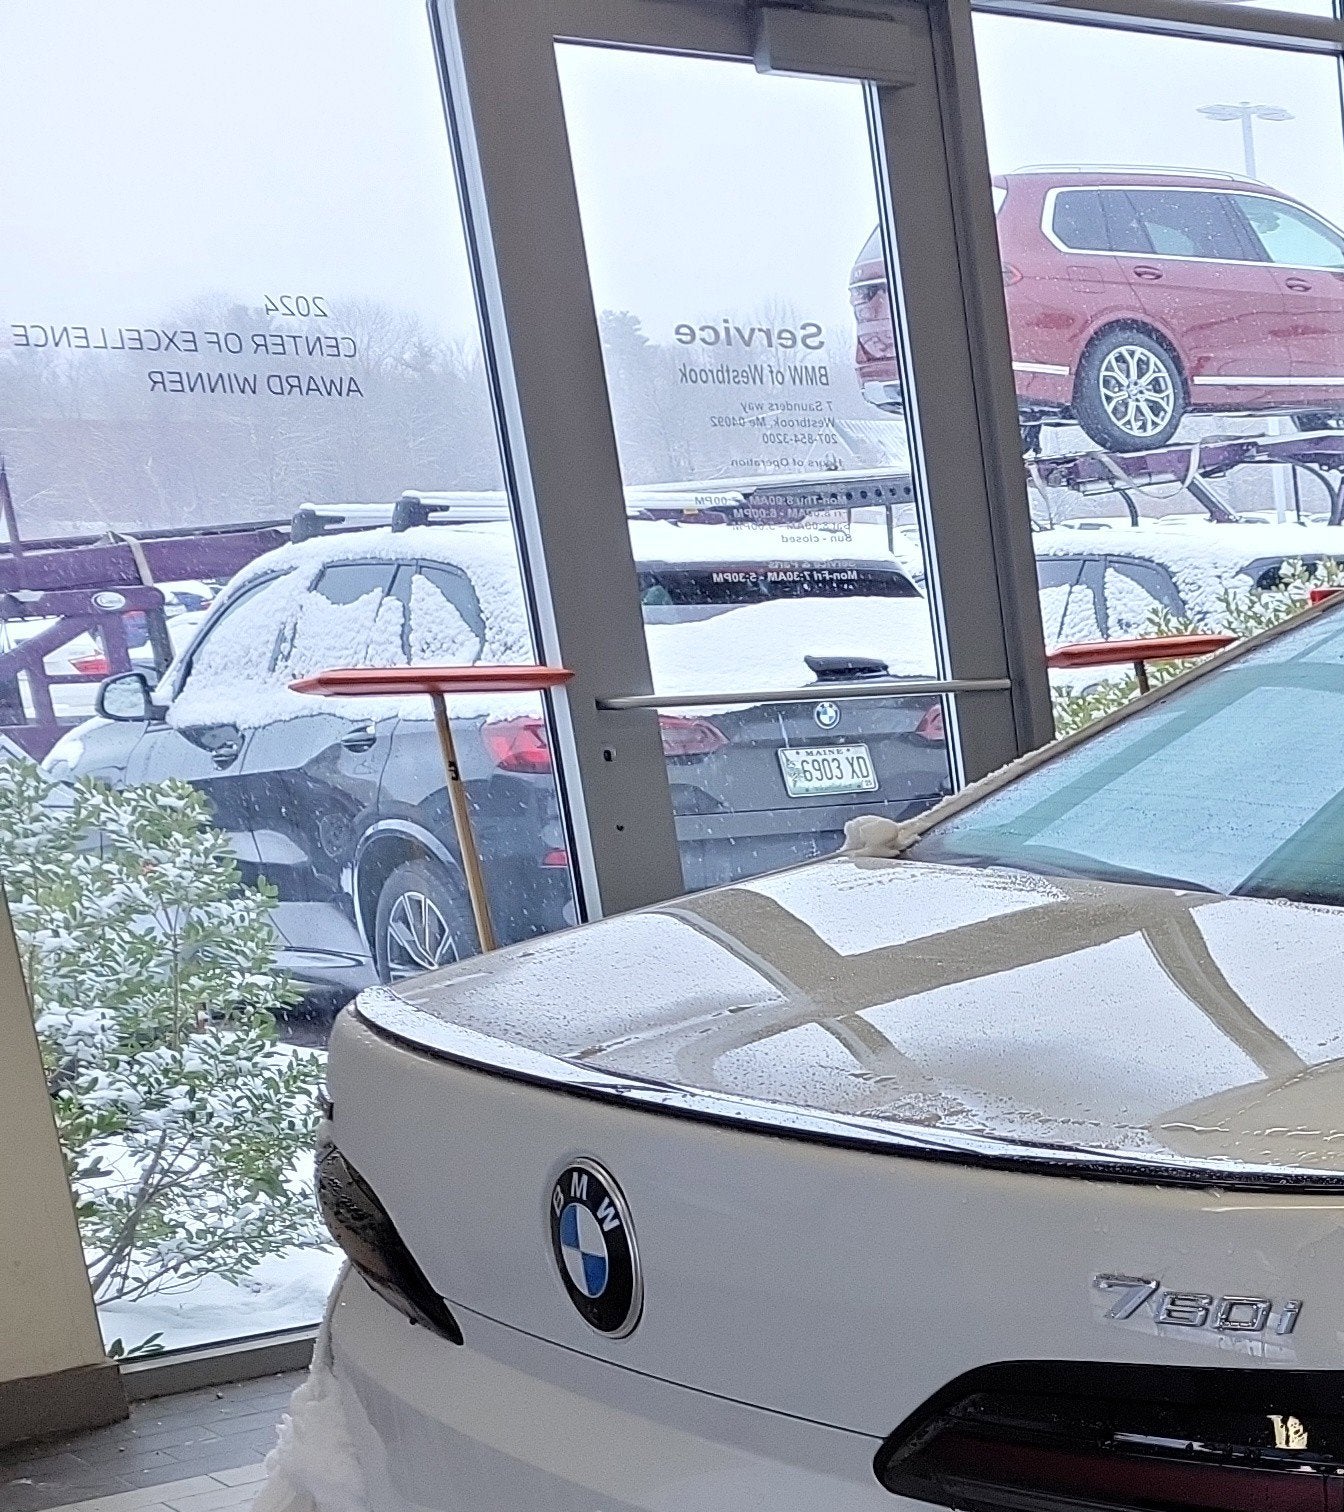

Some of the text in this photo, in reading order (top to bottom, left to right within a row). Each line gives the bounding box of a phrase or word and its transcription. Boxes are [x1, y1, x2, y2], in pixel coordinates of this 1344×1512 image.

[800, 755, 870, 782] 6903 XD
[805, 748, 845, 757] MAINE
[552, 1171, 621, 1232] BMW
[1092, 1273, 1303, 1335] 760i
